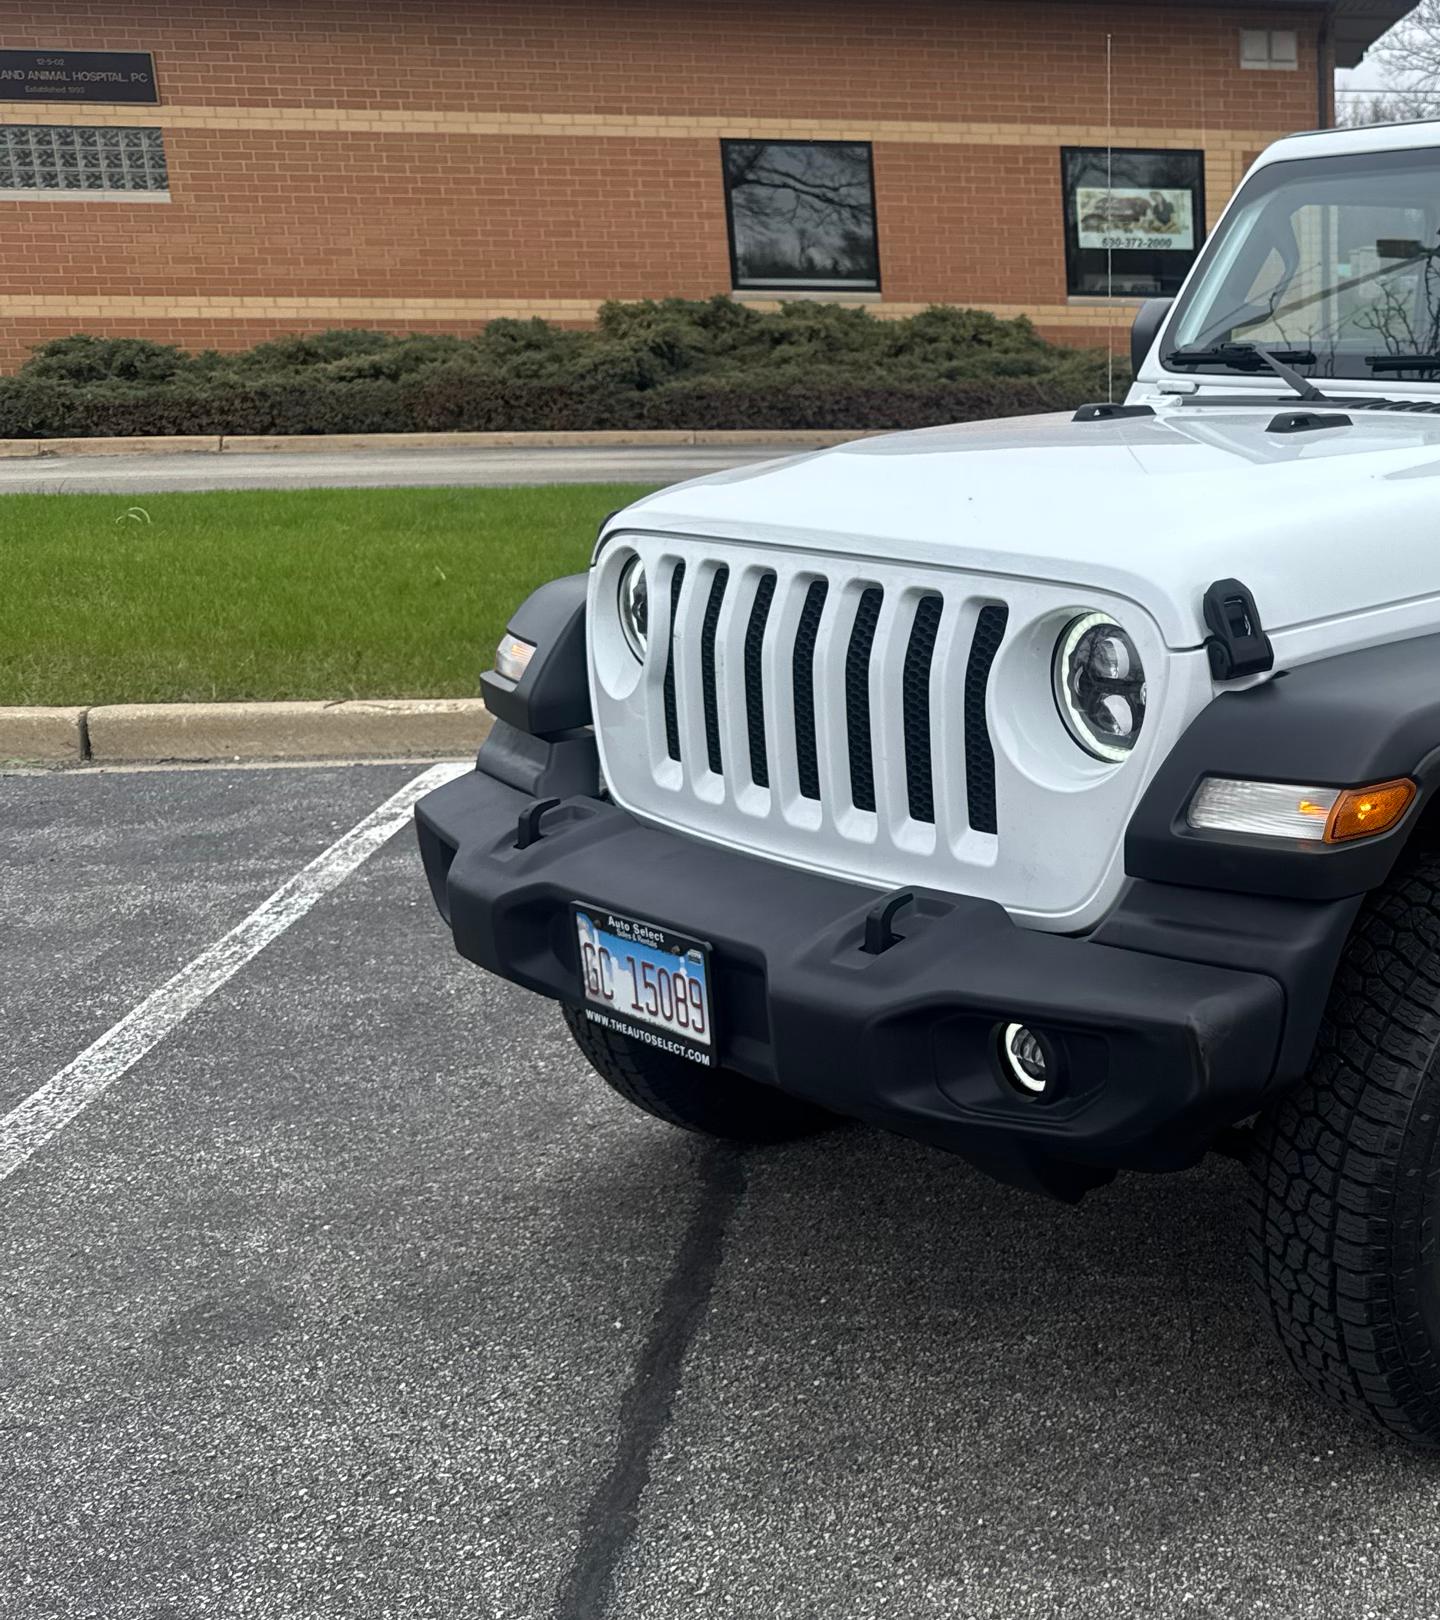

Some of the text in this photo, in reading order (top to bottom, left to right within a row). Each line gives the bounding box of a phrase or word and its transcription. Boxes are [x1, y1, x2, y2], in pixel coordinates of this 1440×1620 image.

[28, 70, 71, 81] ANIMAL
[131, 72, 148, 82] PC
[1102, 238, 1172, 249] 630-372-2000
[608, 915, 664, 943] Auto Select
[583, 942, 614, 1000] GC
[627, 956, 705, 1034] 15089
[585, 1009, 711, 1067] WWW.THEAUTOSELECT.COM
